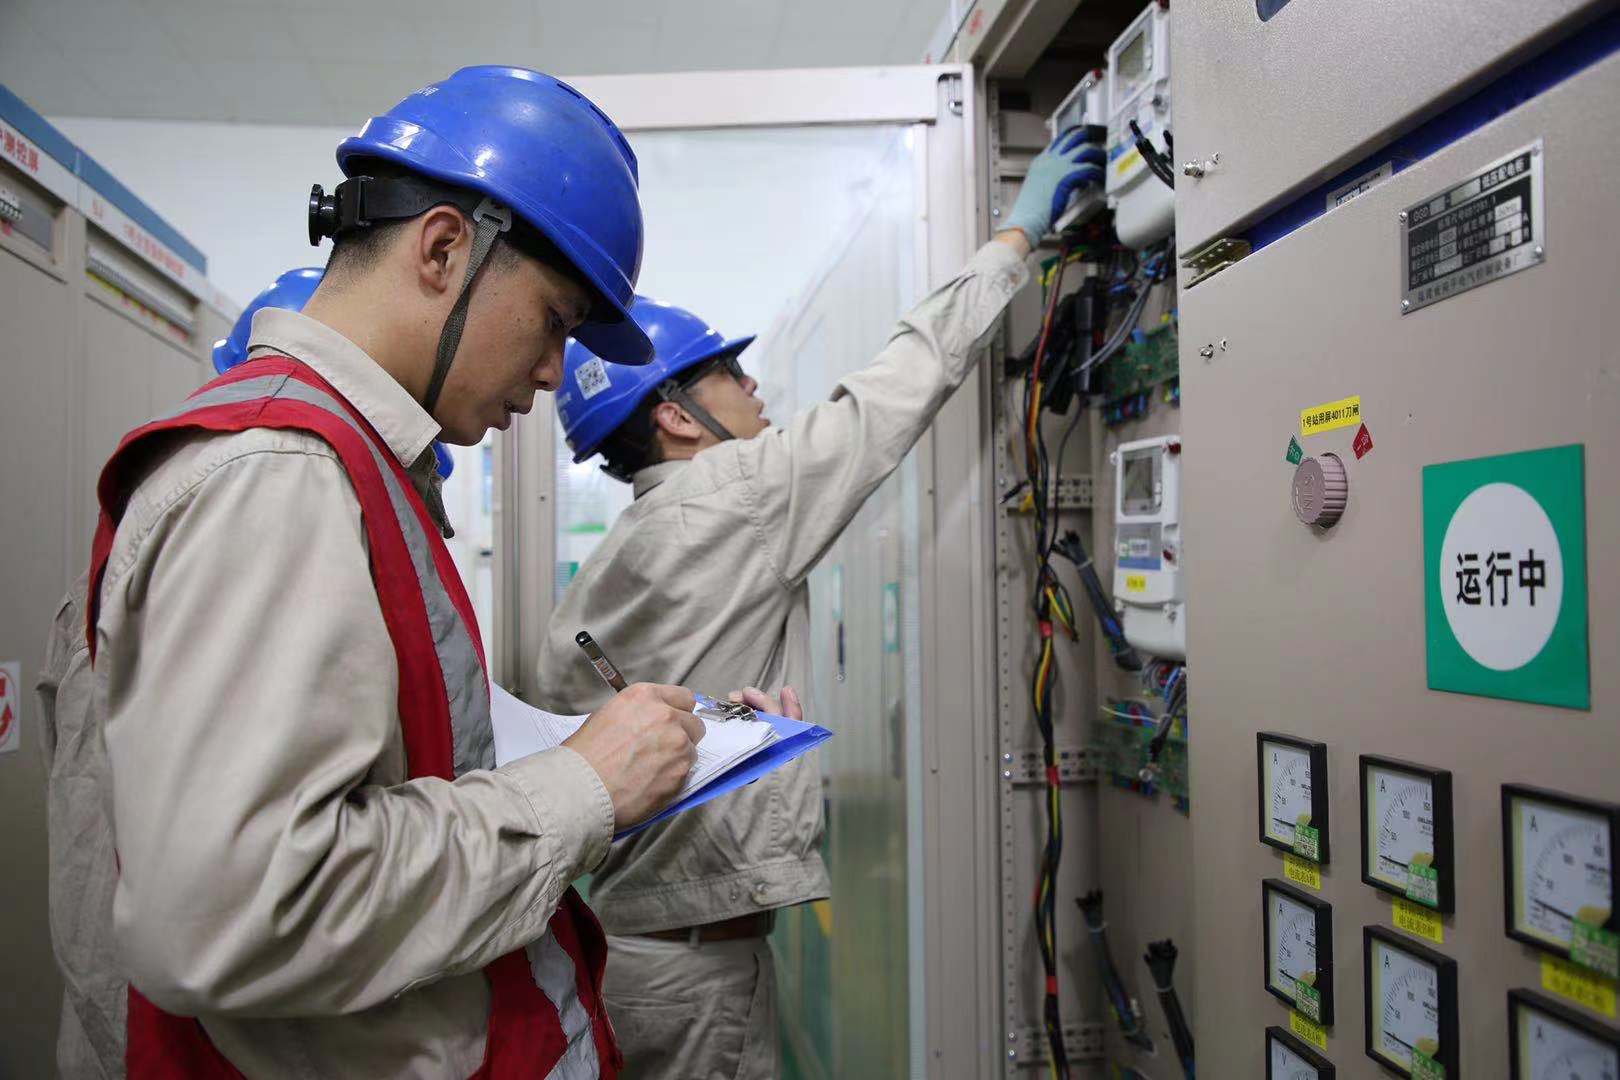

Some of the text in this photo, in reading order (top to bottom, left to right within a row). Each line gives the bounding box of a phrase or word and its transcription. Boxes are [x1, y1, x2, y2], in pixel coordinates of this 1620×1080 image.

[1456, 549, 1546, 608] 运行中
[1380, 778, 1387, 794] A
[1529, 814, 1539, 833] A
[1384, 955, 1390, 968] A
